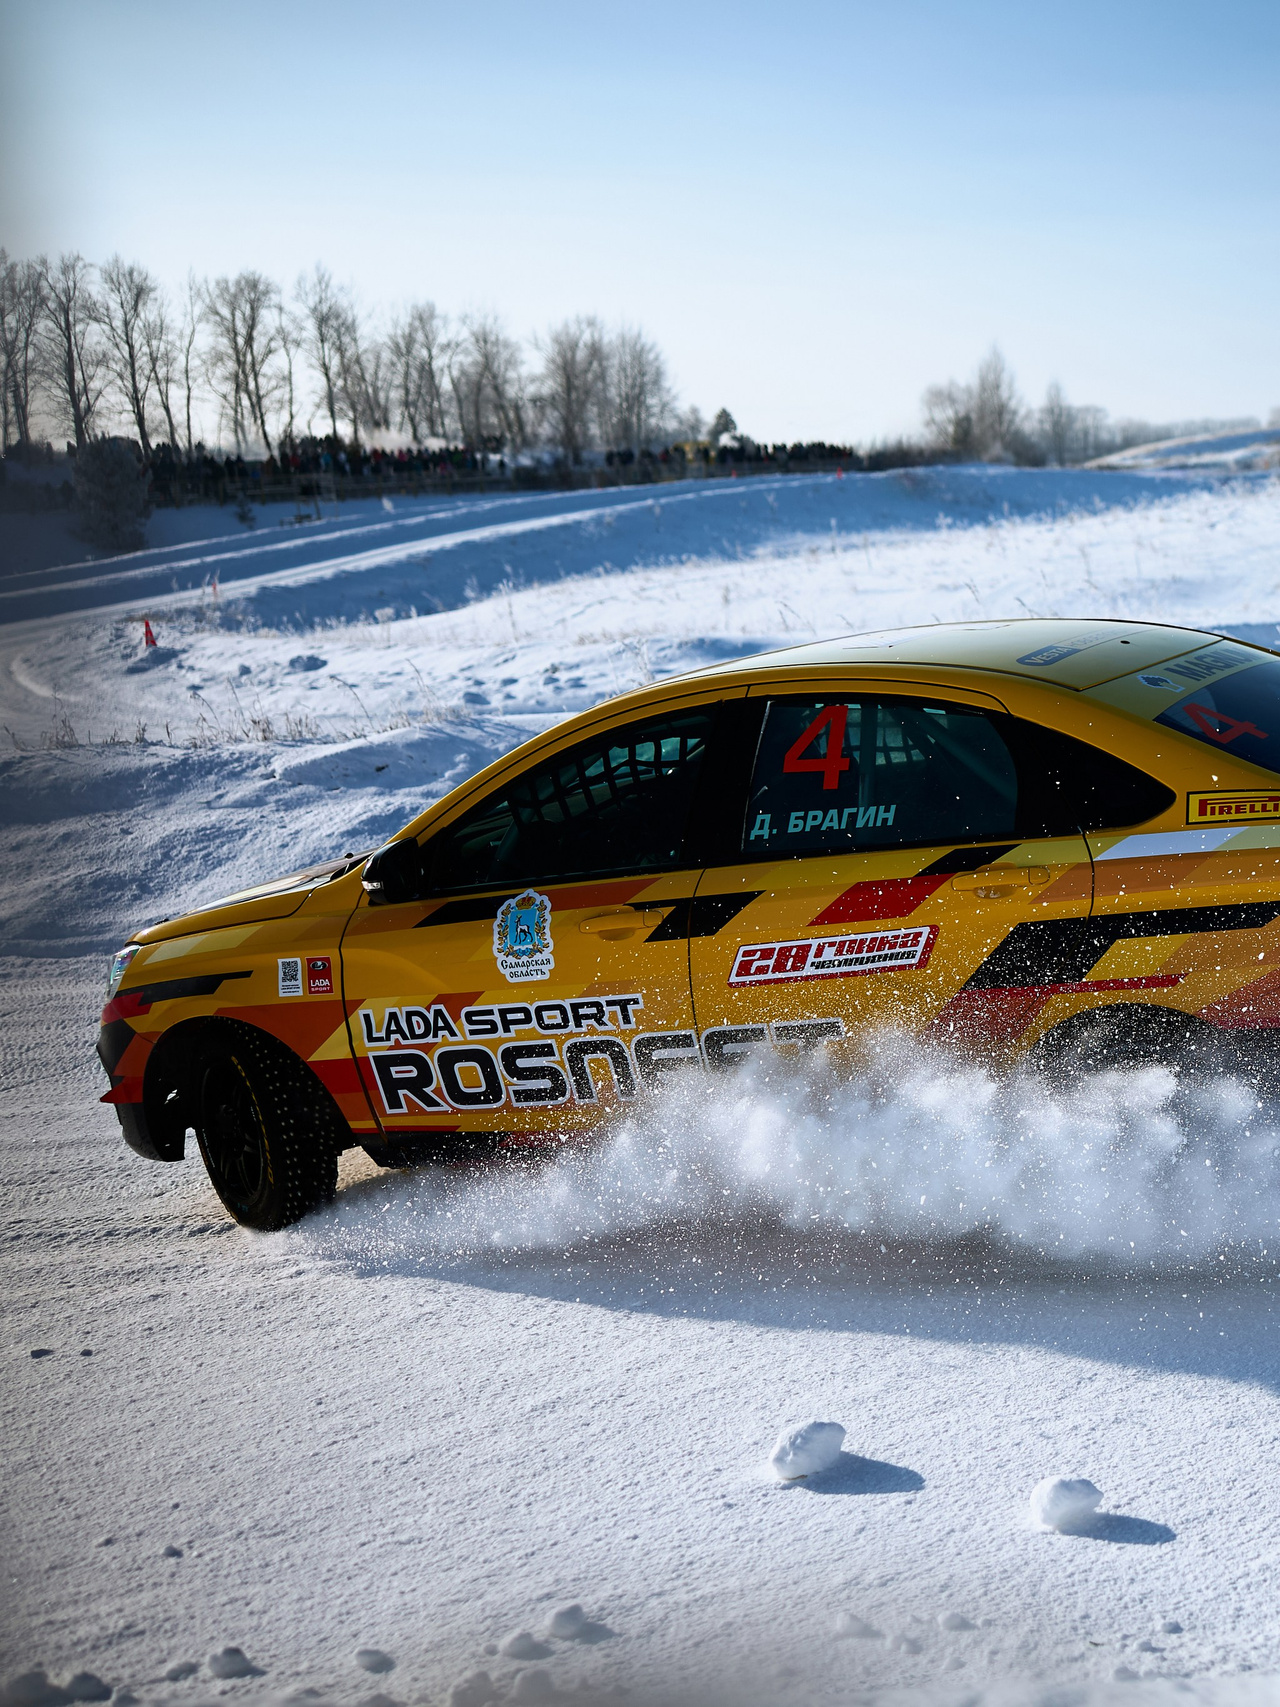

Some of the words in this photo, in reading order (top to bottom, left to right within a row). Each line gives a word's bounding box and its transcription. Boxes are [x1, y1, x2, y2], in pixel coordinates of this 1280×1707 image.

[1025, 646, 1072, 664] VESTA
[1182, 703, 1269, 744] 4
[783, 705, 850, 790] 4
[1198, 796, 1280, 817] PIRELLI
[749, 813, 777, 841] Д.
[787, 804, 897, 833] БРАГИН
[501, 958, 551, 970] Самарская
[509, 968, 546, 979] область
[735, 944, 812, 977] 28
[310, 979, 330, 987] LADA
[360, 1006, 460, 1045] LADA
[464, 996, 642, 1037] SPORT
